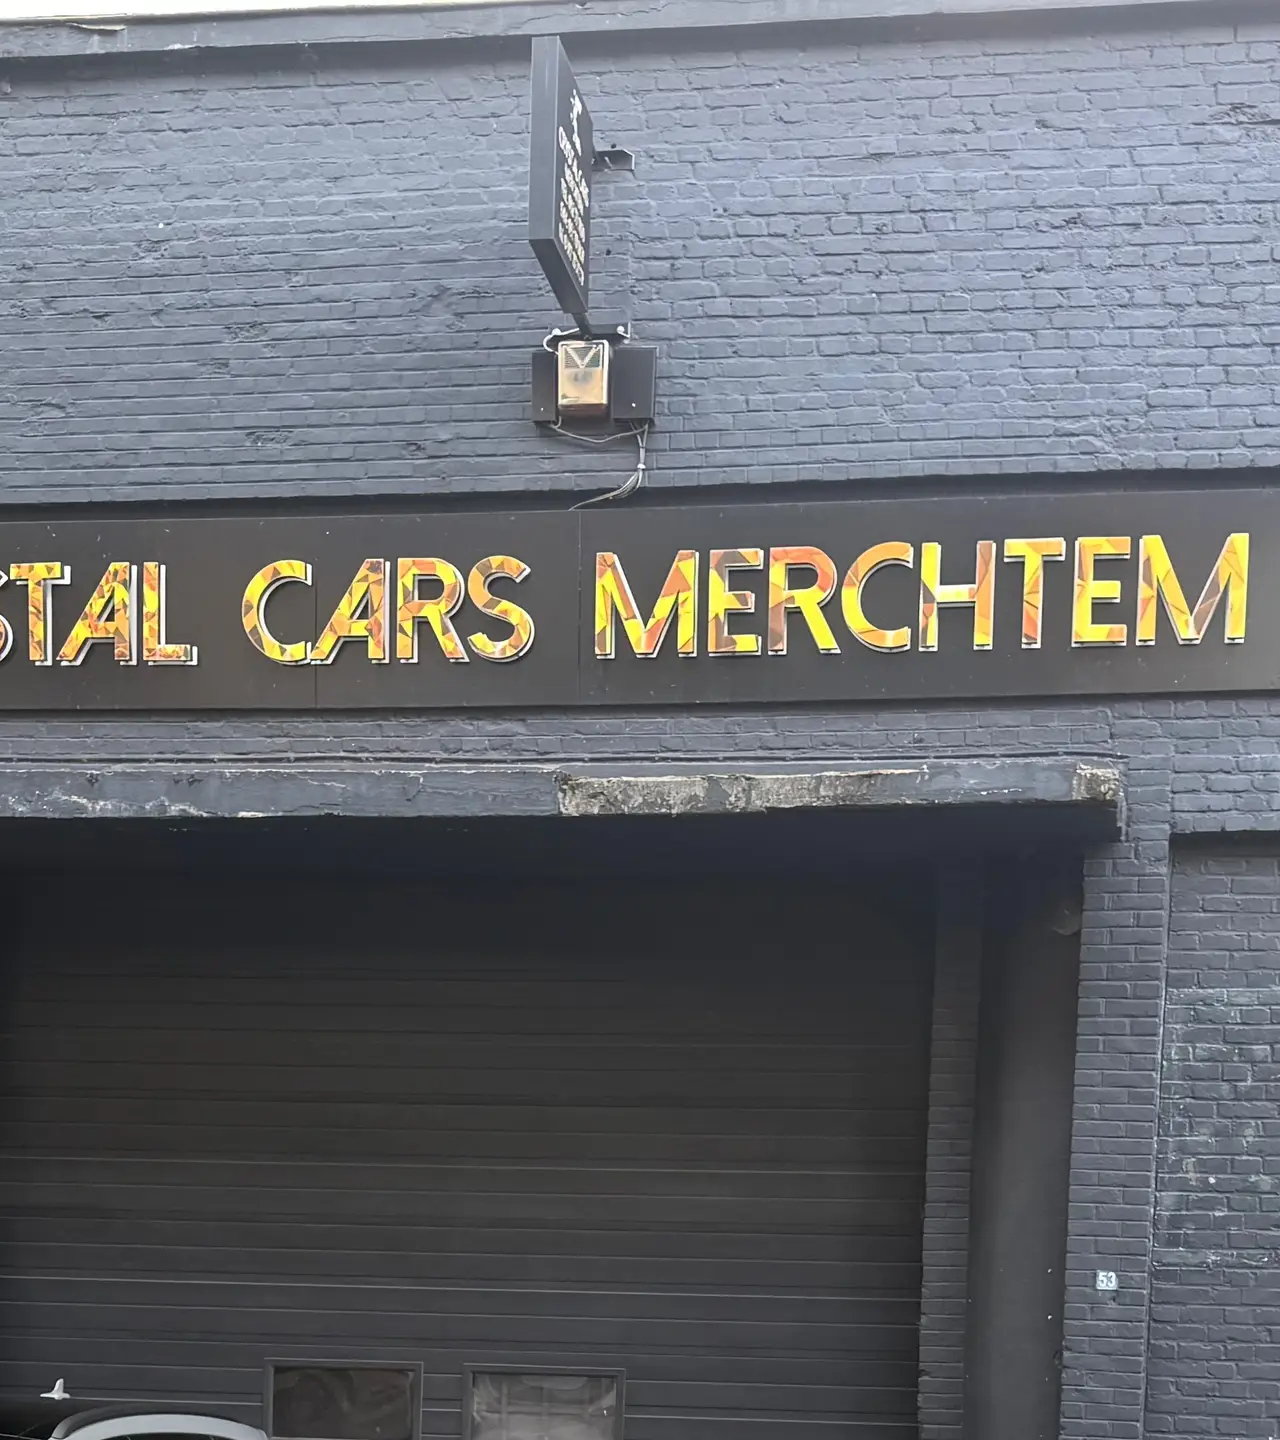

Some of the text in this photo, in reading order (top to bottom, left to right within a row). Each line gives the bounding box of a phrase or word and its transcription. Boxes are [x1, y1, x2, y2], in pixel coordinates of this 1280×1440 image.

[241, 554, 535, 665] CARS
[594, 532, 1250, 659] MERCHTEM
[1098, 1271, 1117, 1288] 53
